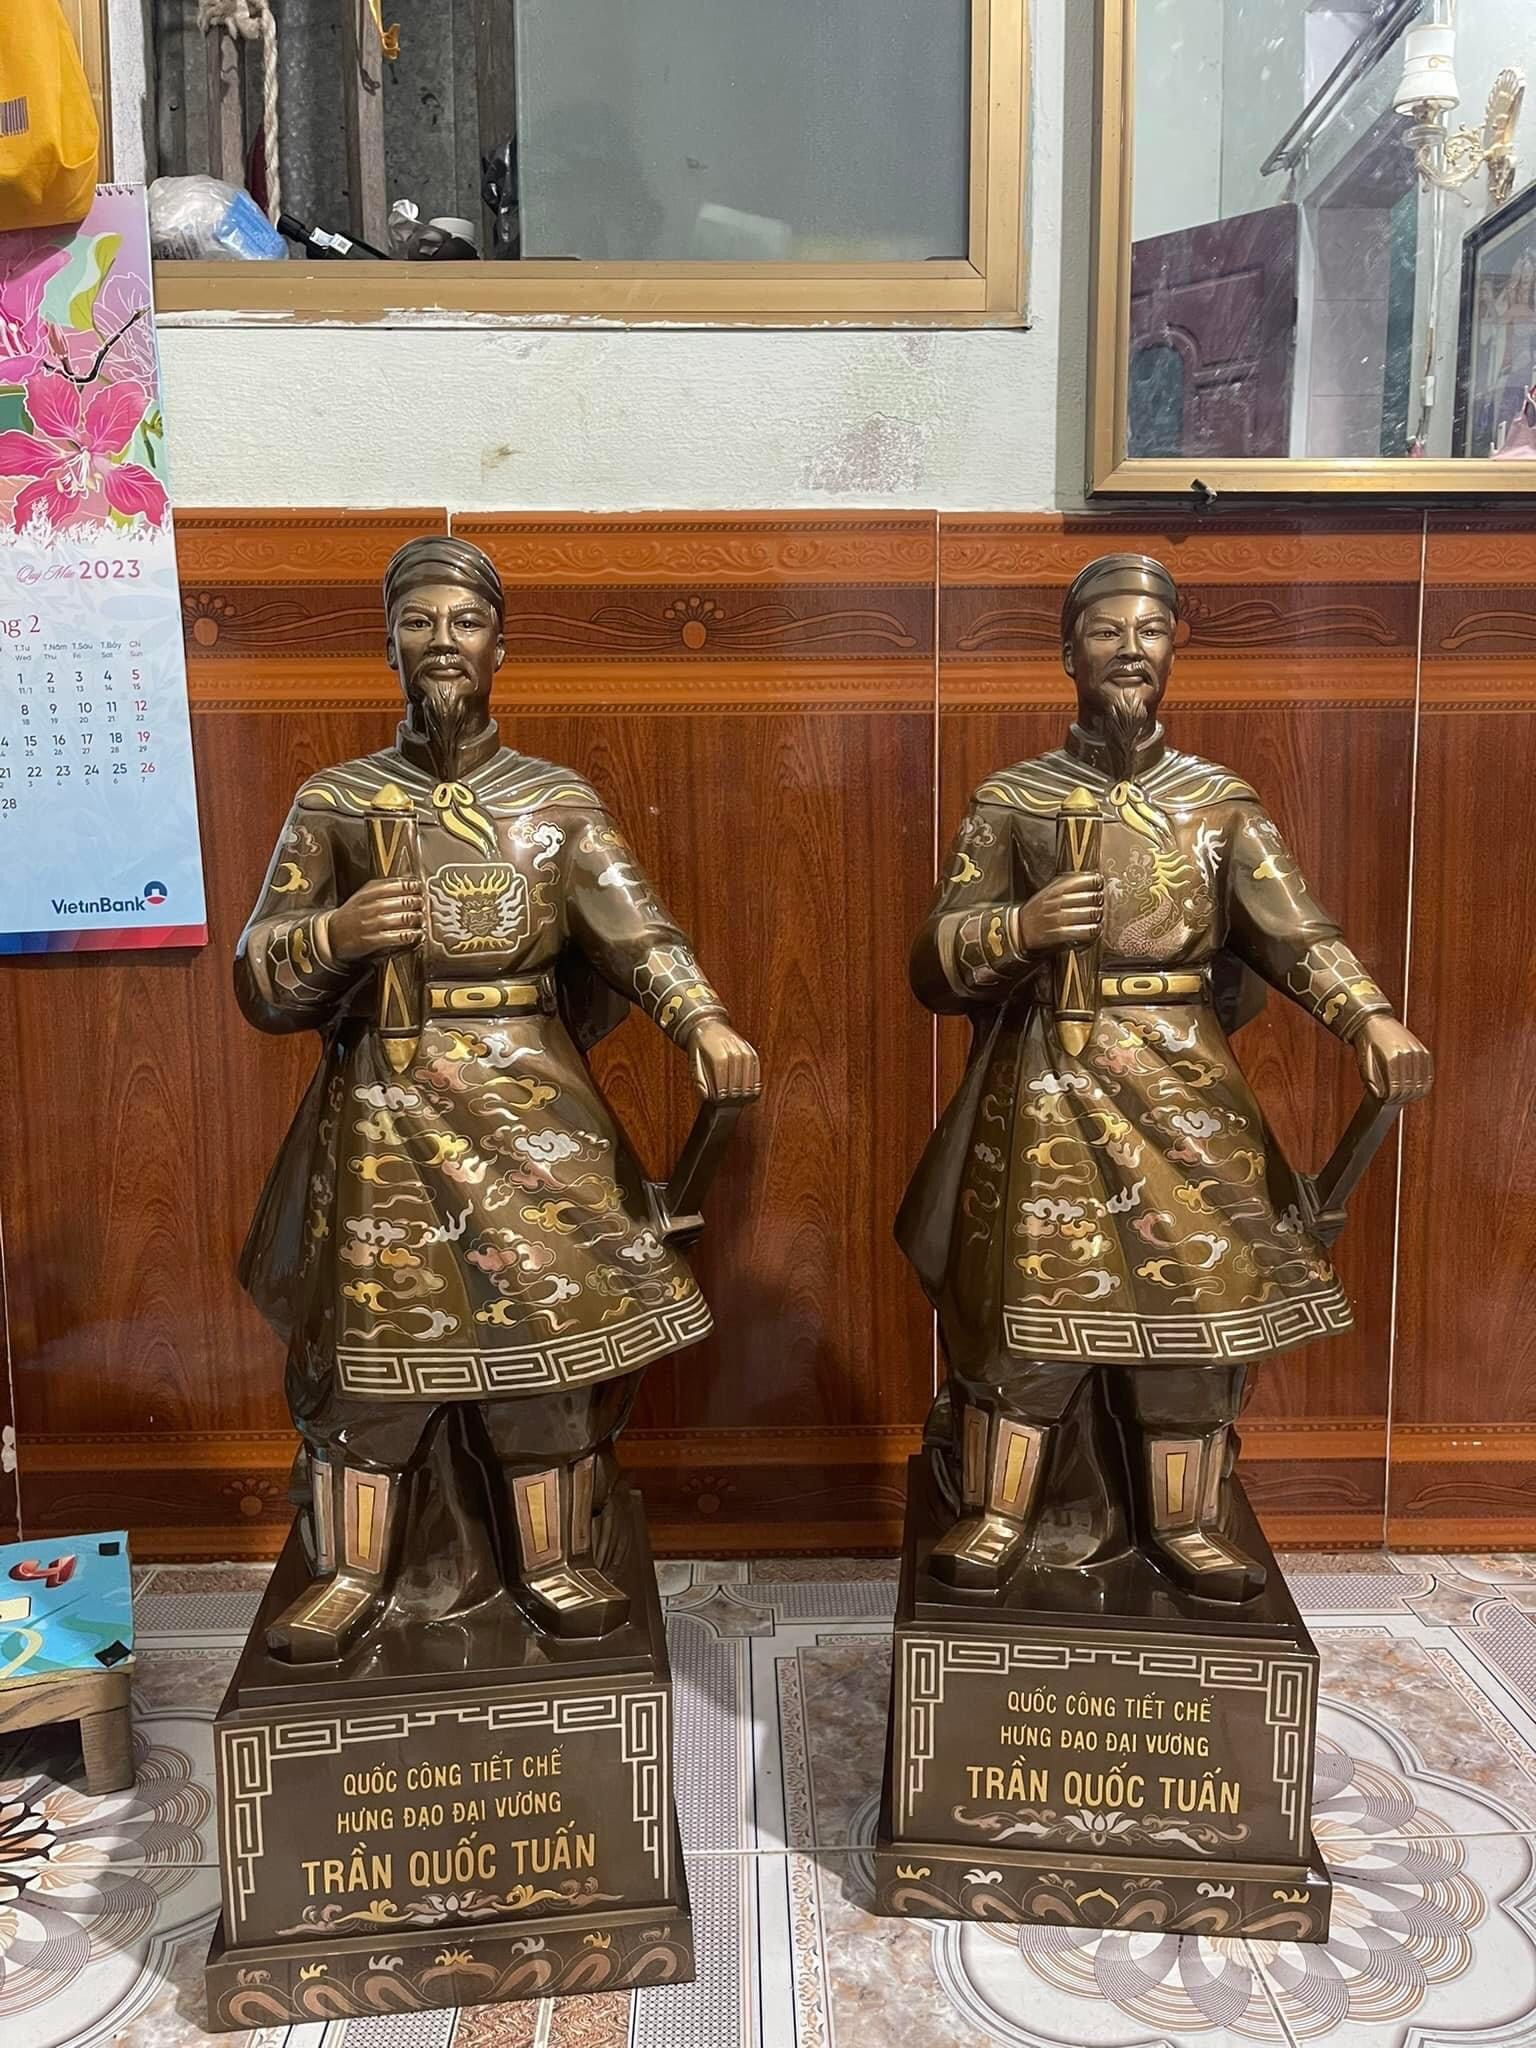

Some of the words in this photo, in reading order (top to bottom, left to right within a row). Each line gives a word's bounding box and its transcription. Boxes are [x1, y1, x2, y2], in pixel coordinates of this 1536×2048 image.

[79, 558, 141, 580] 2023
[28, 613, 41, 633] 2
[17, 673, 23, 684] 1
[46, 672, 55, 683] 2
[75, 671, 83, 682] 3
[103, 669, 112, 681] 4
[131, 669, 140, 680] 5
[76, 685, 84, 693] 13
[20, 704, 29, 716] 8
[49, 703, 58, 714] 9
[78, 702, 93, 713] 10
[106, 701, 117, 713] 11
[135, 699, 148, 712] 12
[79, 716, 89, 724] 20
[107, 715, 116, 723] 21
[24, 735, 38, 747] 15
[52, 734, 66, 746] 16
[81, 733, 93, 745] 17
[109, 732, 123, 744] 18
[137, 730, 151, 742] 19
[82, 747, 91, 755] 27
[0, 767, 11, 779] 21
[27, 766, 42, 778] 22
[56, 765, 71, 777] 23
[84, 764, 99, 776] 24
[112, 763, 128, 775] 25
[140, 762, 156, 773] 26
[1, 798, 17, 810] 28
[51, 896, 146, 914] VietinBank
[1007, 1684, 1057, 1714] QUỐC
[1065, 1690, 1117, 1718] CÔNG
[1125, 1691, 1166, 1720] TIẾT
[1173, 1694, 1215, 1723] CHẾ
[1000, 1724, 1052, 1748] HƯNG
[1060, 1729, 1098, 1755] ĐẠO
[1105, 1731, 1137, 1756] ĐẠI
[1145, 1732, 1209, 1758] VƯƠNG
[343, 1760, 398, 1797] QUỐC
[406, 1760, 462, 1791] CÔNG
[470, 1750, 514, 1784] TIẾT
[522, 1744, 565, 1778] CHẾ
[966, 1754, 1049, 1803] TRẦN
[1063, 1761, 1146, 1809] QUỐC
[1158, 1766, 1241, 1815] TUẤN
[337, 1806, 394, 1835] HƯNG
[403, 1803, 444, 1831] ĐẠO
[452, 1799, 487, 1826] ĐẠI
[495, 1790, 562, 1819] VƯƠNG
[301, 1841, 392, 1897] TRẦN
[408, 1831, 497, 1888] QUỐC
[510, 1819, 596, 1876] TUẤN
